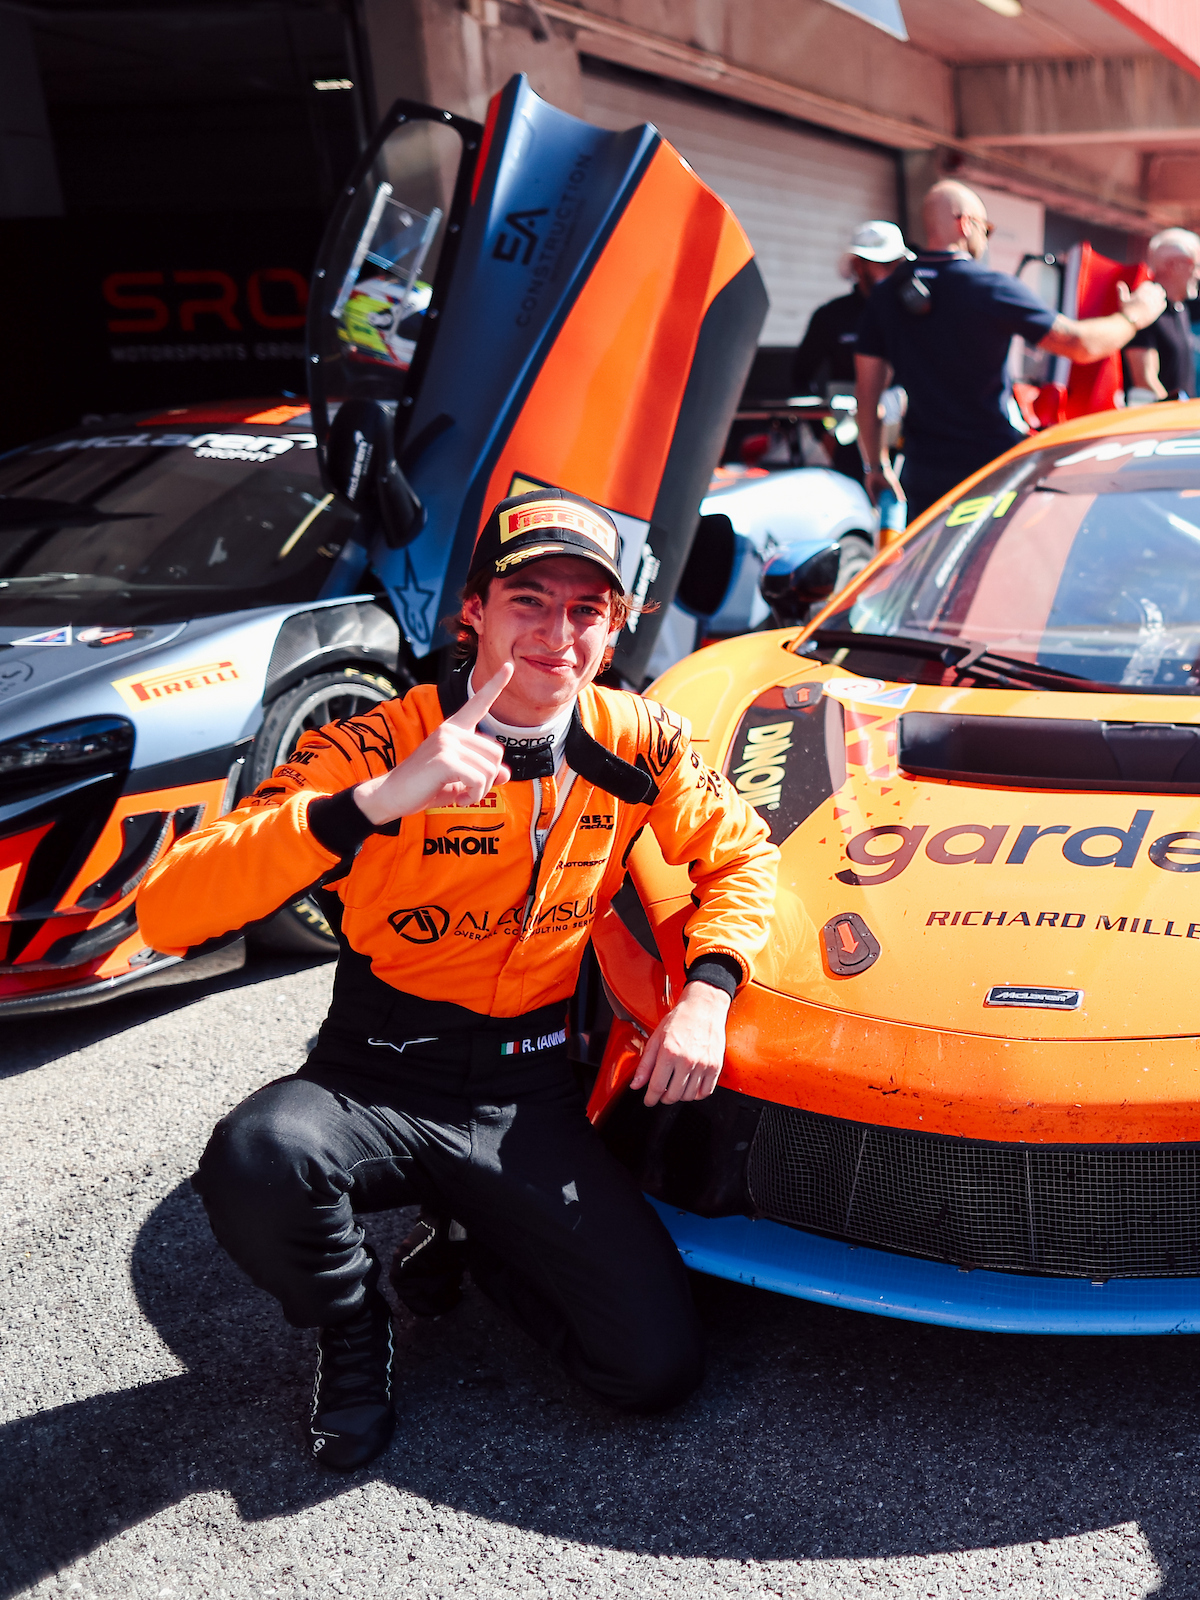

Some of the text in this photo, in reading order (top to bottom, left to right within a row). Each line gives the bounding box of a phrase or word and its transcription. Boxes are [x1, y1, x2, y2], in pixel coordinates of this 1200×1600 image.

[102, 268, 308, 333] SRO
[508, 505, 608, 546] PIRELLI
[945, 490, 1018, 528] 81
[131, 661, 239, 702] PIRELLI
[925, 910, 1085, 930] RICHARD
[995, 991, 1067, 1002] McLaren
[522, 1038, 536, 1053] R.
